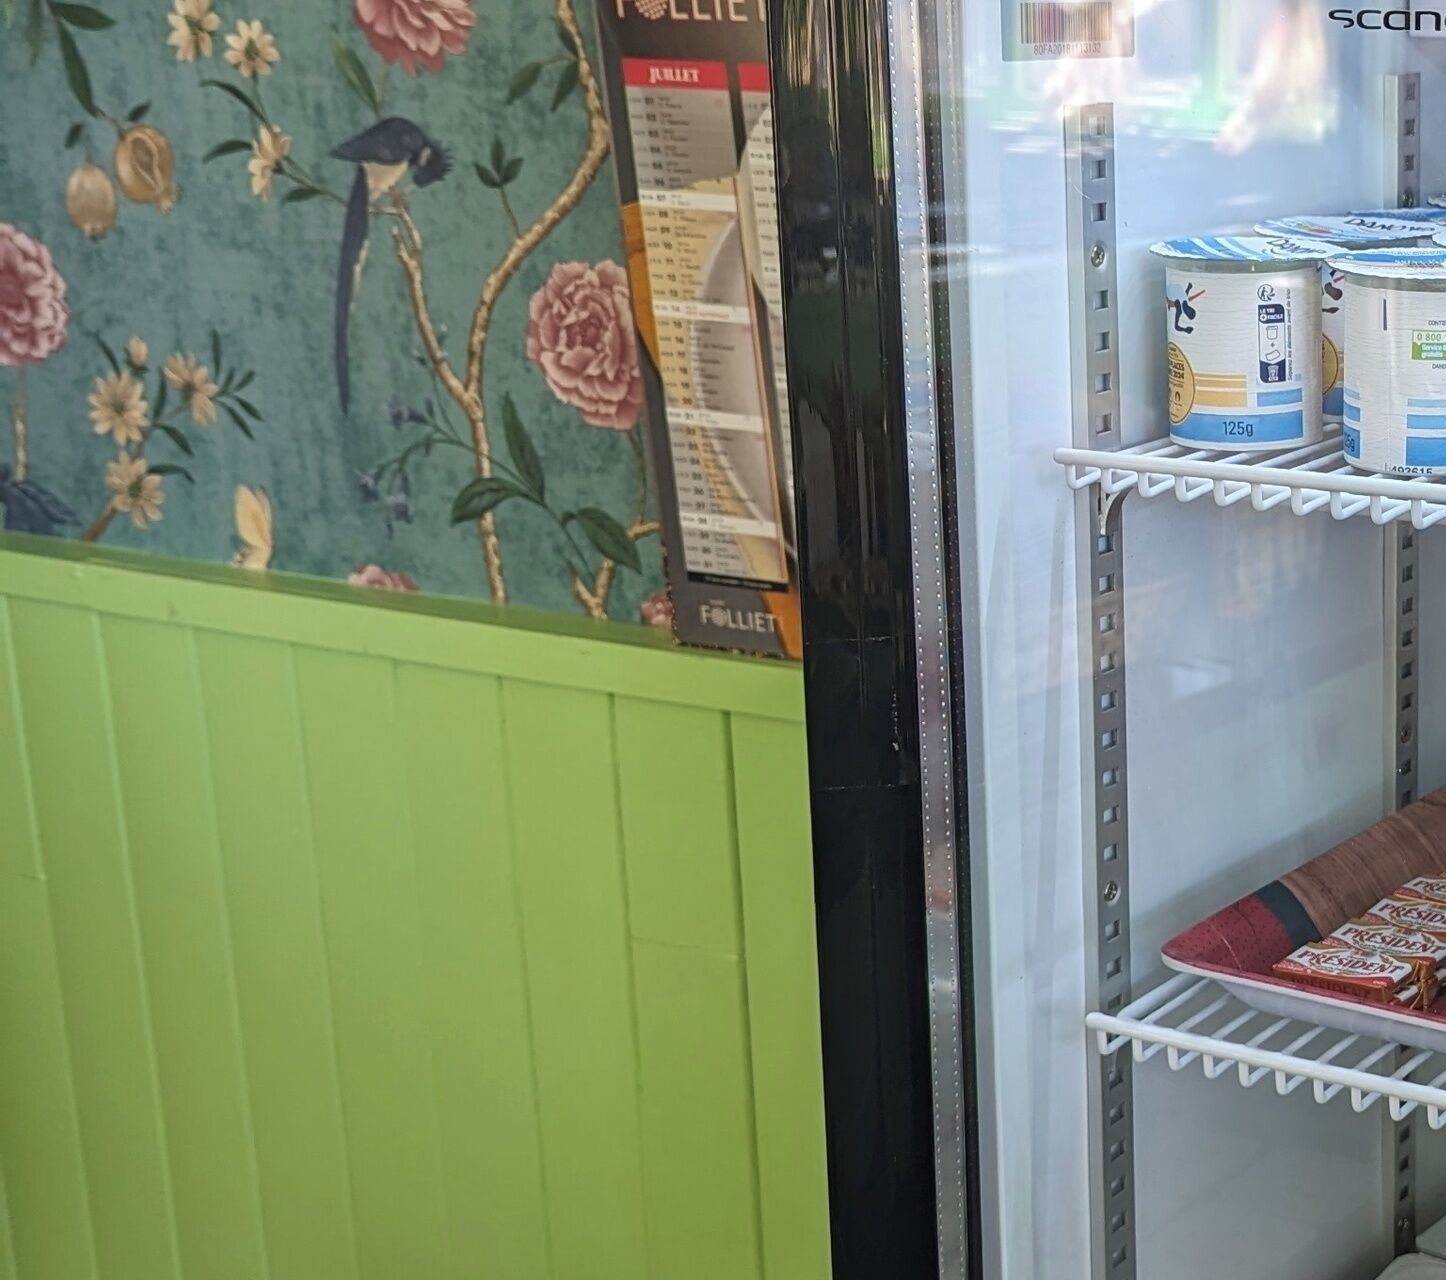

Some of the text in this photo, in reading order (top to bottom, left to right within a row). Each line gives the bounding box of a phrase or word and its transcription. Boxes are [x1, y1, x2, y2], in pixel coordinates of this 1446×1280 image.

[650, 67, 700, 84] JUILLET
[1417, 333, 1422, 341] 0
[1425, 333, 1442, 341] 800
[1222, 421, 1254, 437] 125g
[699, 604, 776, 633] FOLLIET
